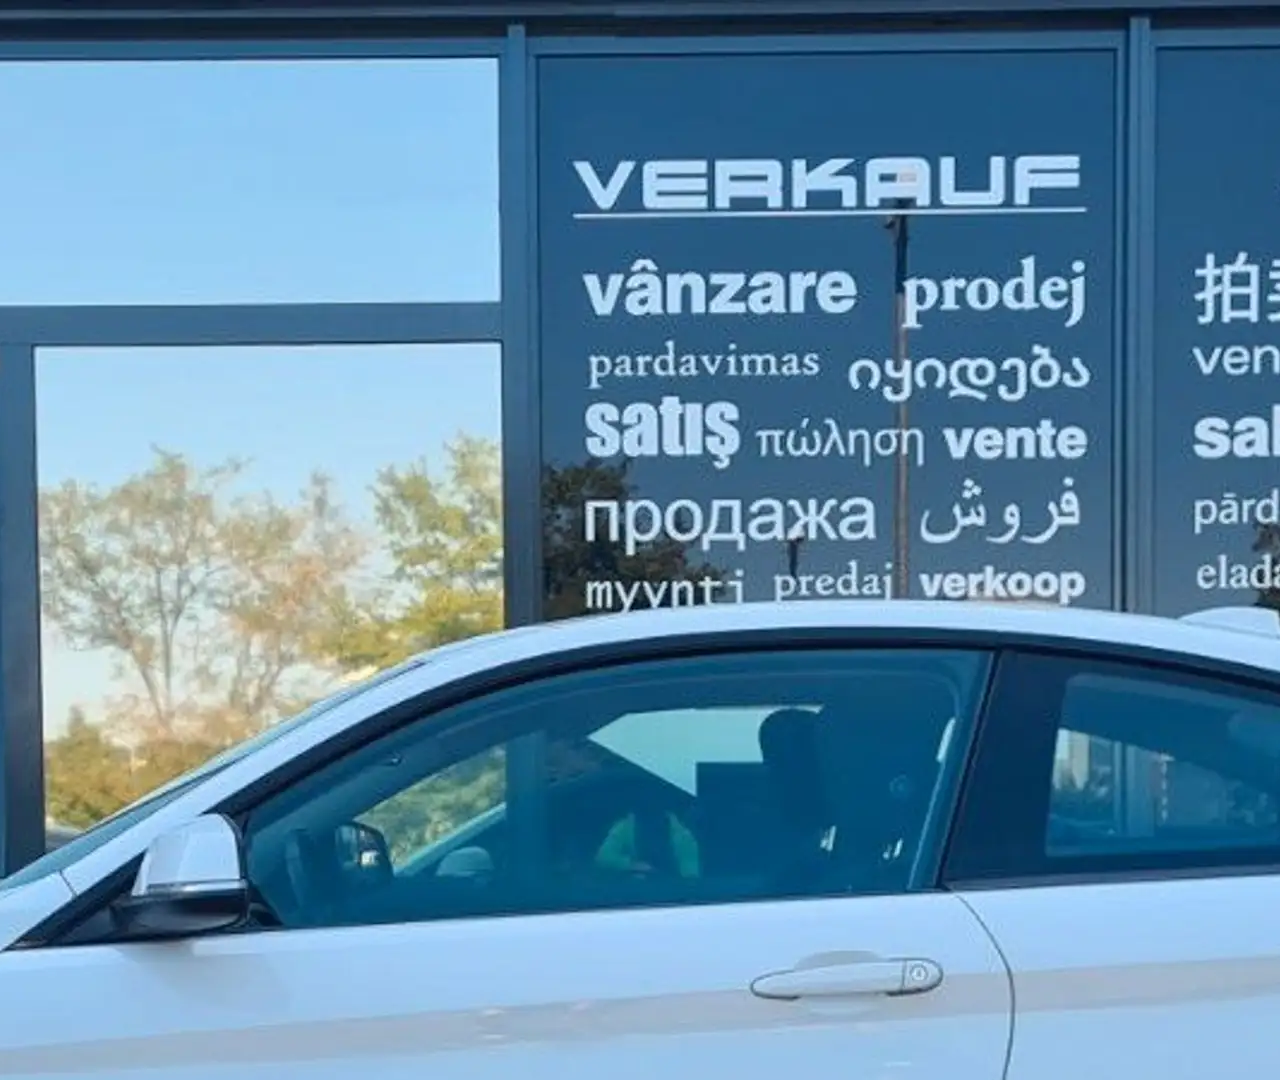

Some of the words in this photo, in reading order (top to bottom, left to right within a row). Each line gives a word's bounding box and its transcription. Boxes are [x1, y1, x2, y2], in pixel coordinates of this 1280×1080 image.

[573, 155, 1081, 209] VERKAUF
[583, 258, 858, 316] vânzare
[901, 255, 1085, 329] prodej
[589, 340, 820, 389] pardavimas
[848, 344, 1090, 402] იყიდება
[585, 396, 740, 470] satış
[755, 417, 924, 467] πώληση
[943, 419, 1088, 460] vente
[585, 497, 877, 556] продажа
[920, 477, 1080, 544] فروش
[774, 559, 893, 600] predaj
[919, 565, 1086, 603] verkoop
